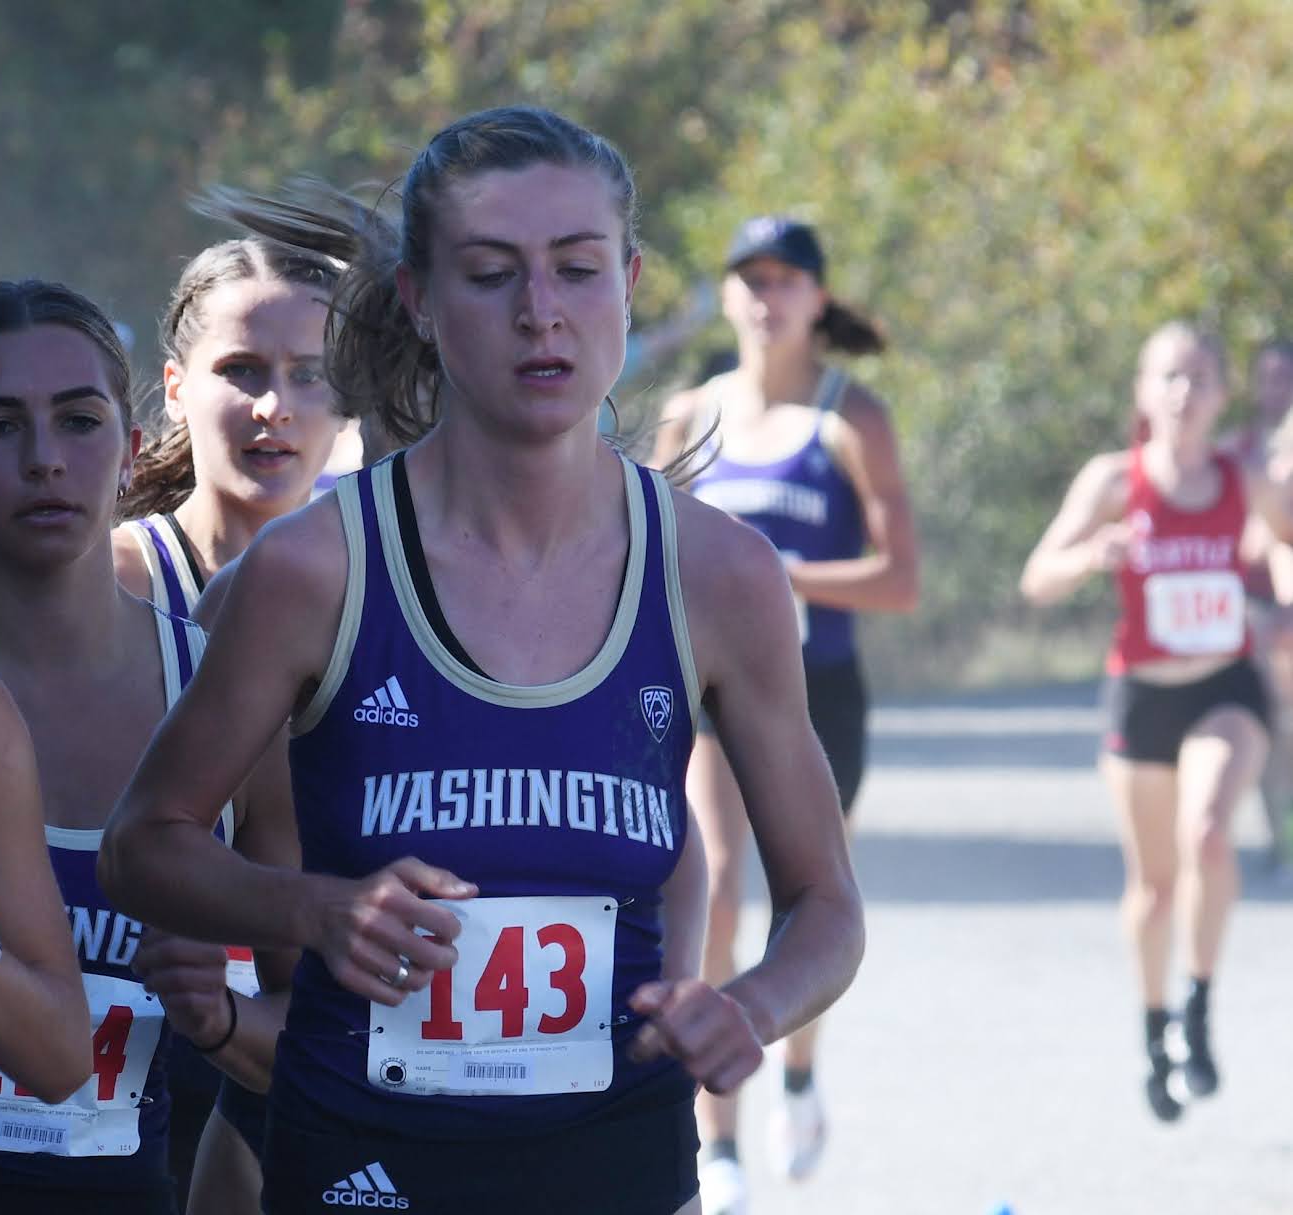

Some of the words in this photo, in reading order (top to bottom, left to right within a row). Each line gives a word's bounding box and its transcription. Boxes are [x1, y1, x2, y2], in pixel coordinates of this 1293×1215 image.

[353, 706, 419, 728] adidas
[643, 691, 670, 718] PAC
[652, 711, 666, 728] 12
[360, 769, 674, 851] WASHINGTON
[421, 923, 587, 1040] 143
[322, 1186, 410, 1211] adidas
